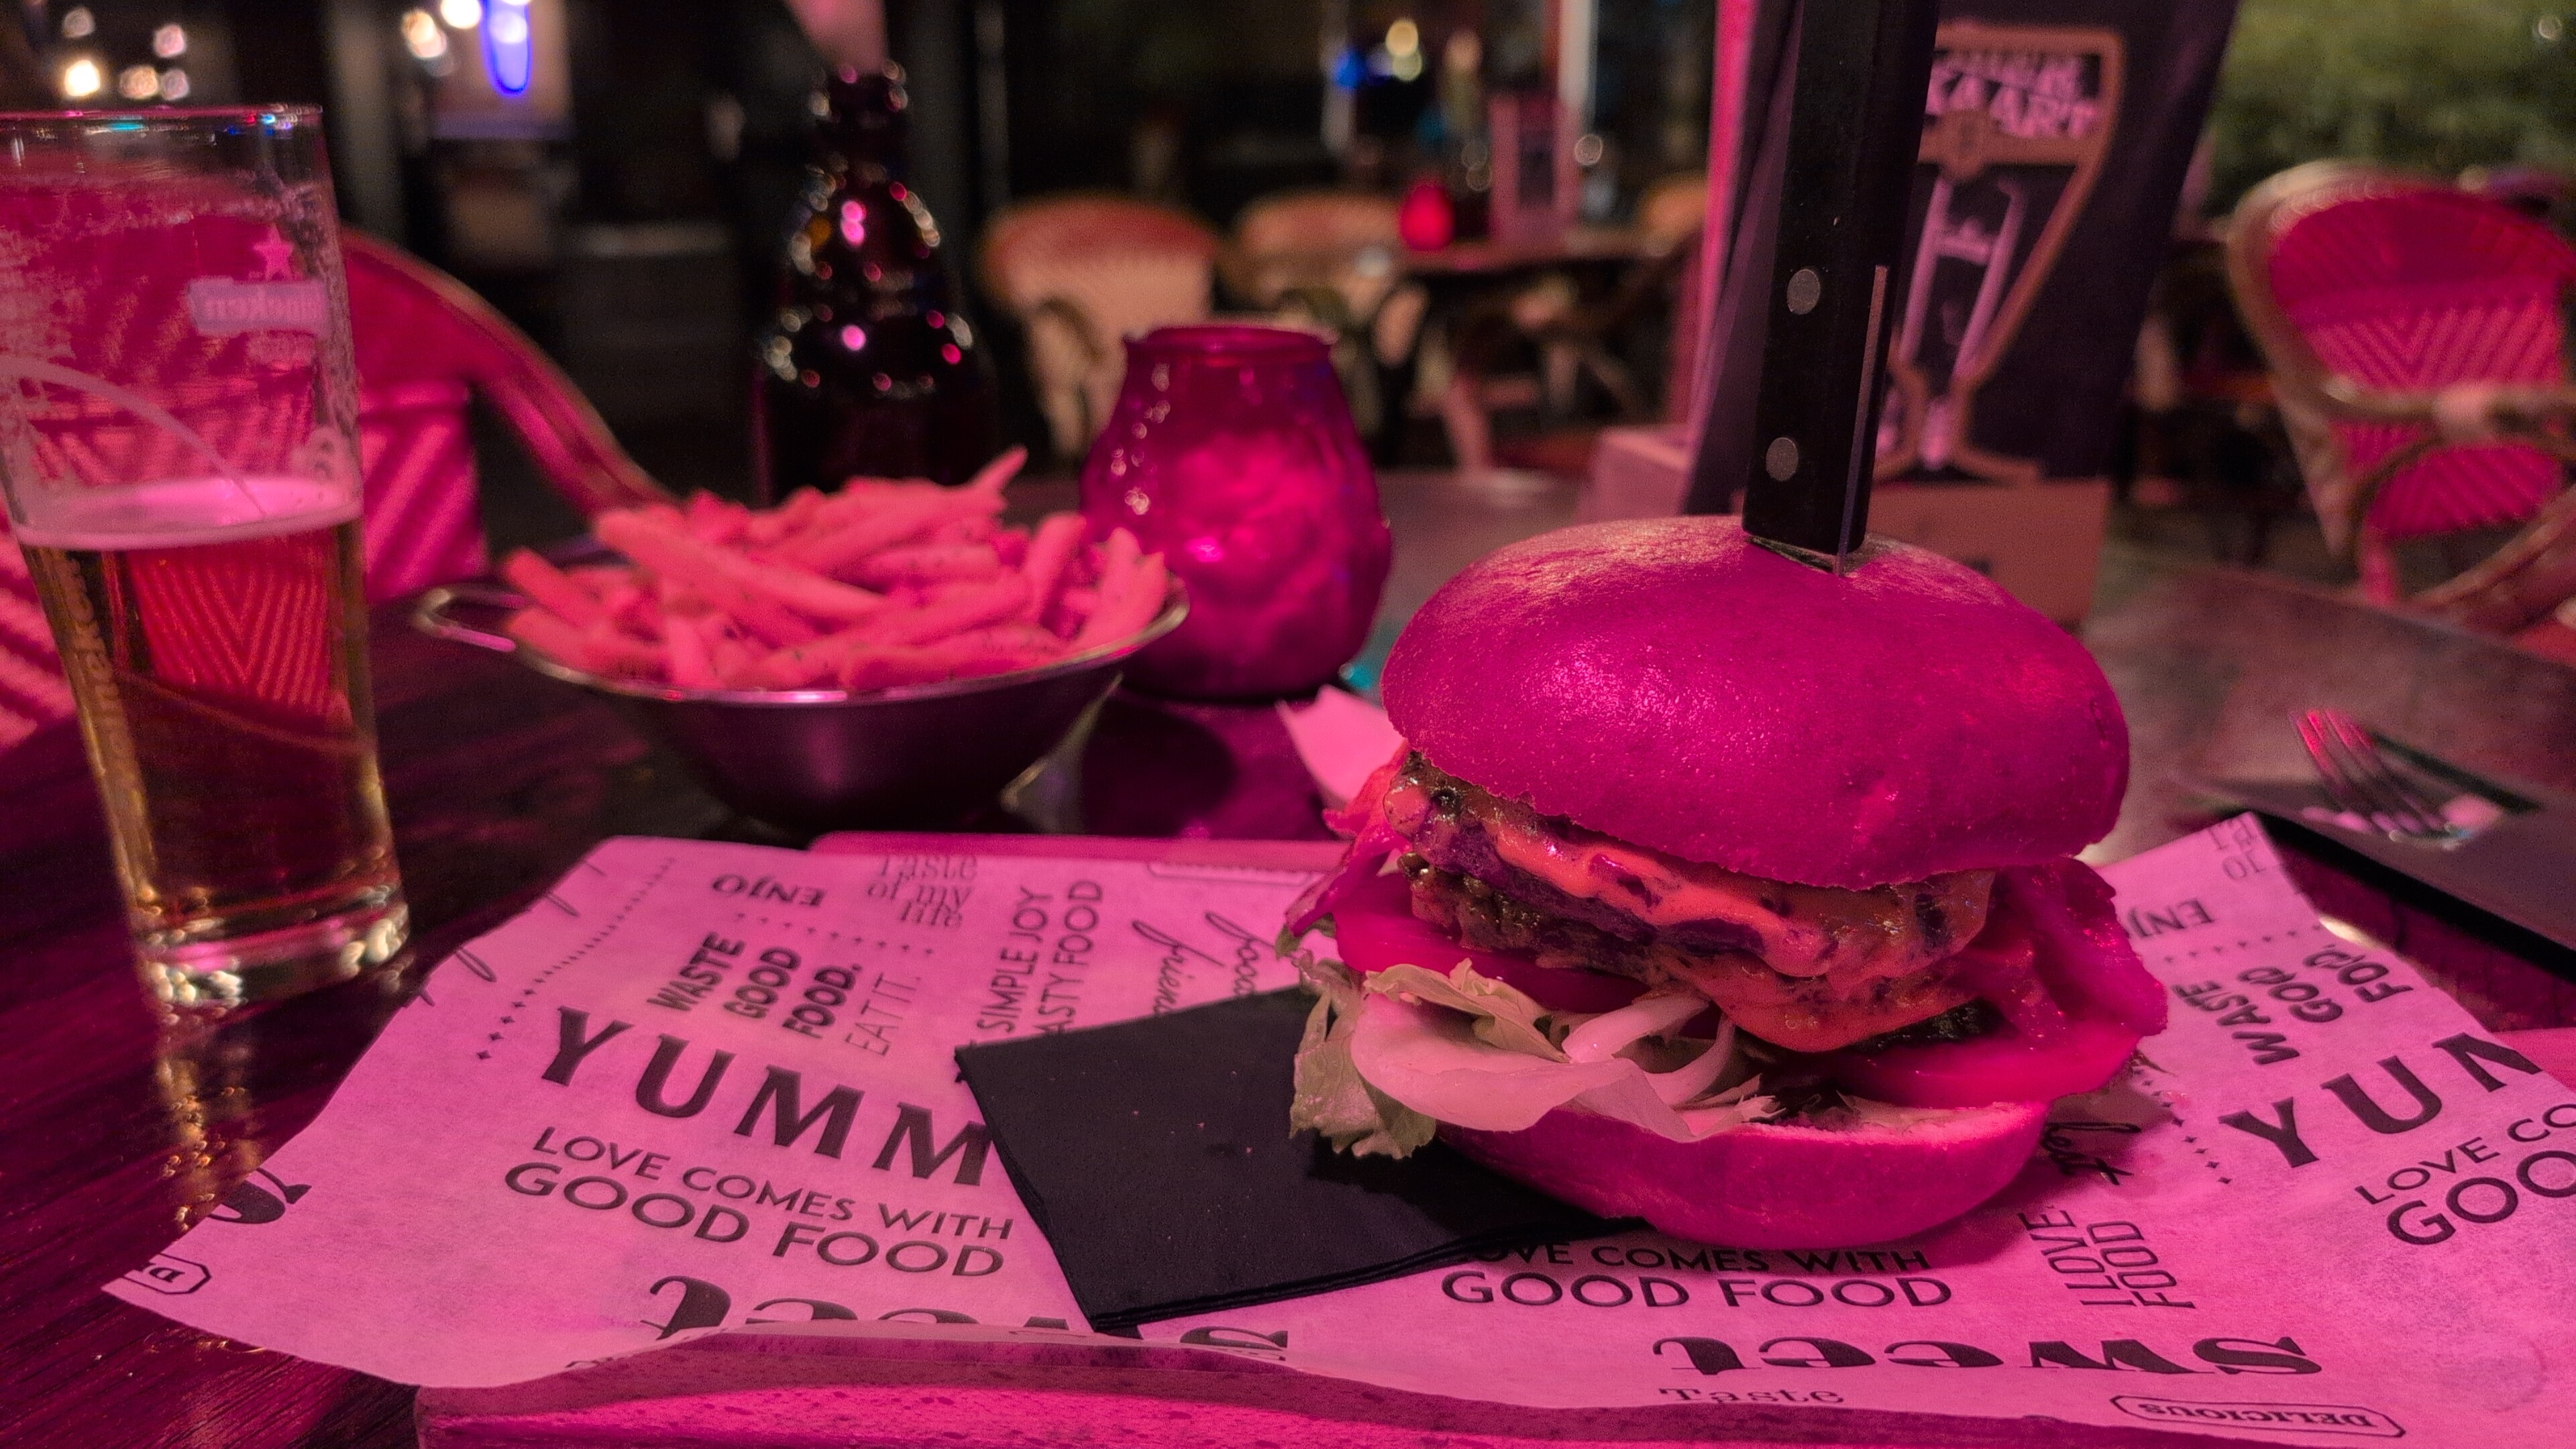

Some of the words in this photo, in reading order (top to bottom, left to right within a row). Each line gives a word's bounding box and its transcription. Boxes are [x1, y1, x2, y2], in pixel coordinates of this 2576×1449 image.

[977, 947, 1039, 1033] SIMPLE
[1008, 885, 1053, 944] JOY
[1053, 879, 1103, 967] FOOD
[646, 931, 745, 1012] WASTE
[722, 947, 803, 1020] GOOD
[782, 963, 863, 1040] FOOD.
[533, 1126, 671, 1181] LOVE
[682, 1166, 856, 1221] COMES
[877, 1202, 1014, 1240] WITH
[2354, 1136, 2501, 1205] LOVE
[504, 1161, 750, 1242] GOOD
[773, 1221, 1004, 1277] FOOD
[2016, 1210, 2121, 1290] LOVE
[1441, 1270, 1690, 1307] GOOD
[1717, 1276, 1952, 1307] FOOD
[1591, 1245, 1770, 1273] COMES
[1781, 1248, 1932, 1273] WITH
[2086, 1220, 2196, 1310] FOOD
[1658, 1388, 1845, 1405] Taste
[2137, 1403, 2377, 1428] DELICIOUS
